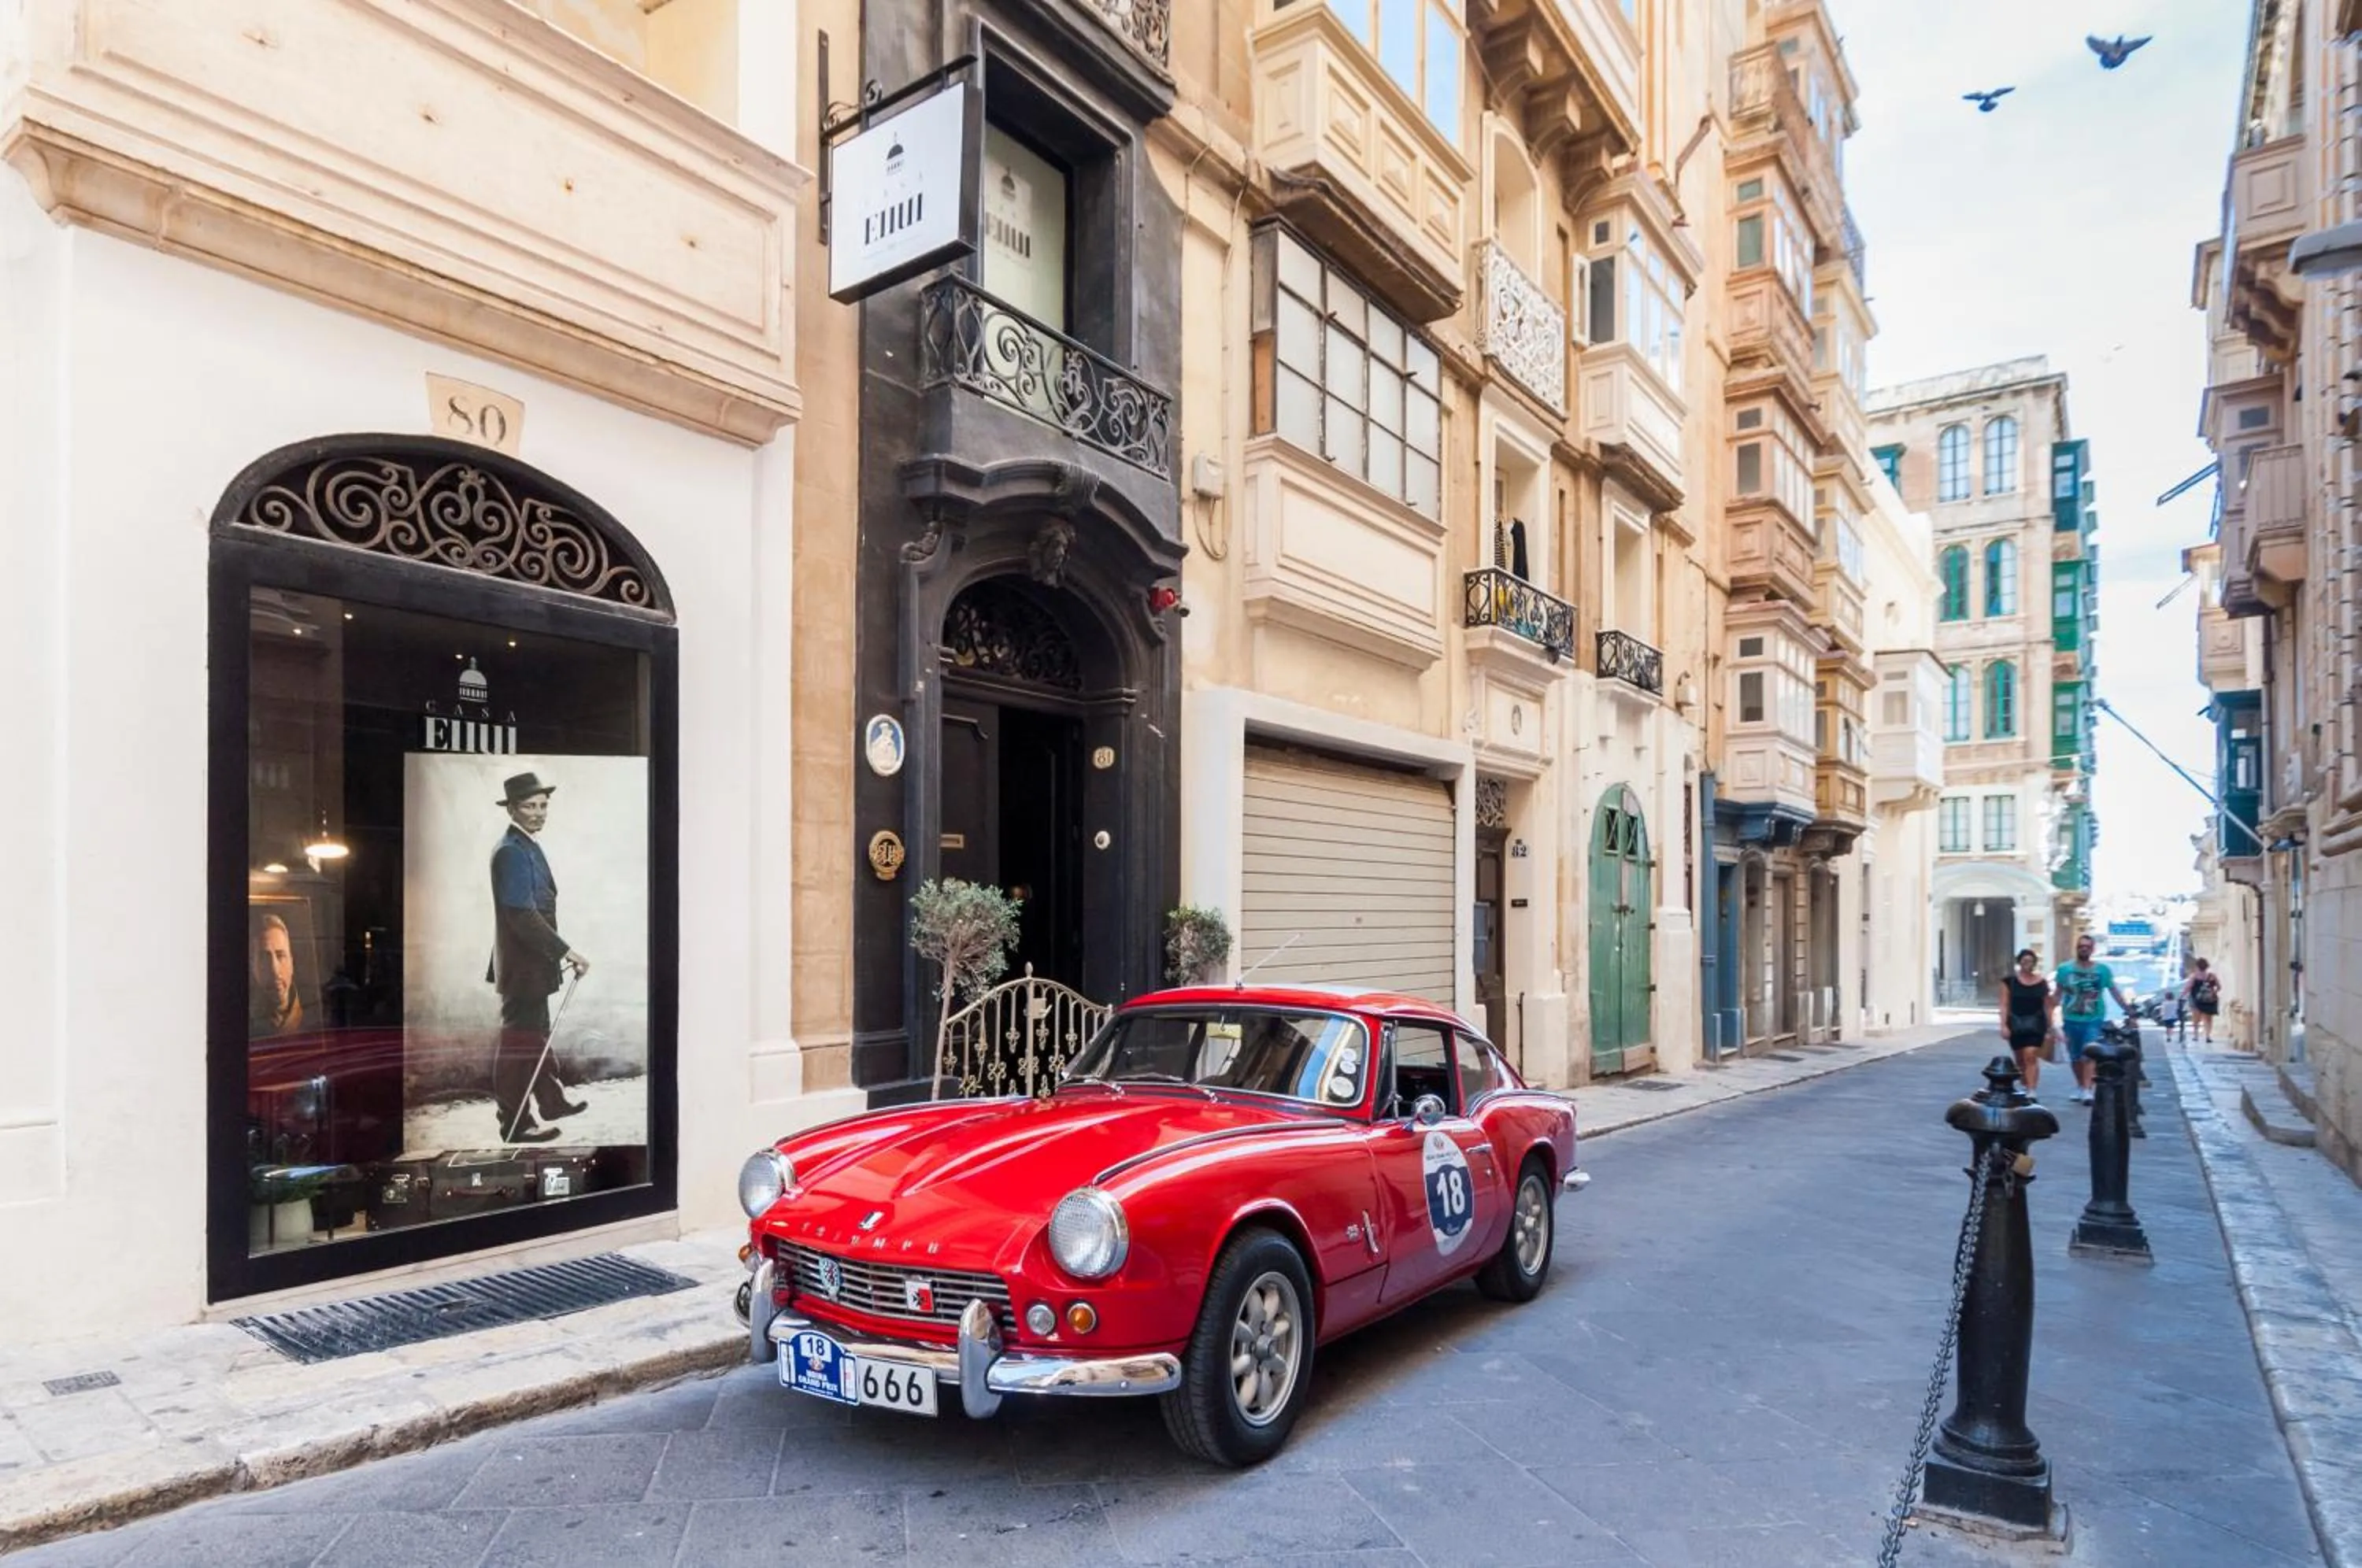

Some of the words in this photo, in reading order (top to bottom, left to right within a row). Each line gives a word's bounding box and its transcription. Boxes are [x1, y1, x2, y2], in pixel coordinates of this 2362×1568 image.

[447, 395, 506, 446] 80
[425, 700, 516, 723] CASA
[1512, 845, 1527, 857] 82
[1436, 1170, 1465, 1218] 18
[801, 1222, 939, 1254] TRIUMPH
[807, 1337, 825, 1356] 18
[863, 1365, 924, 1406] 666
